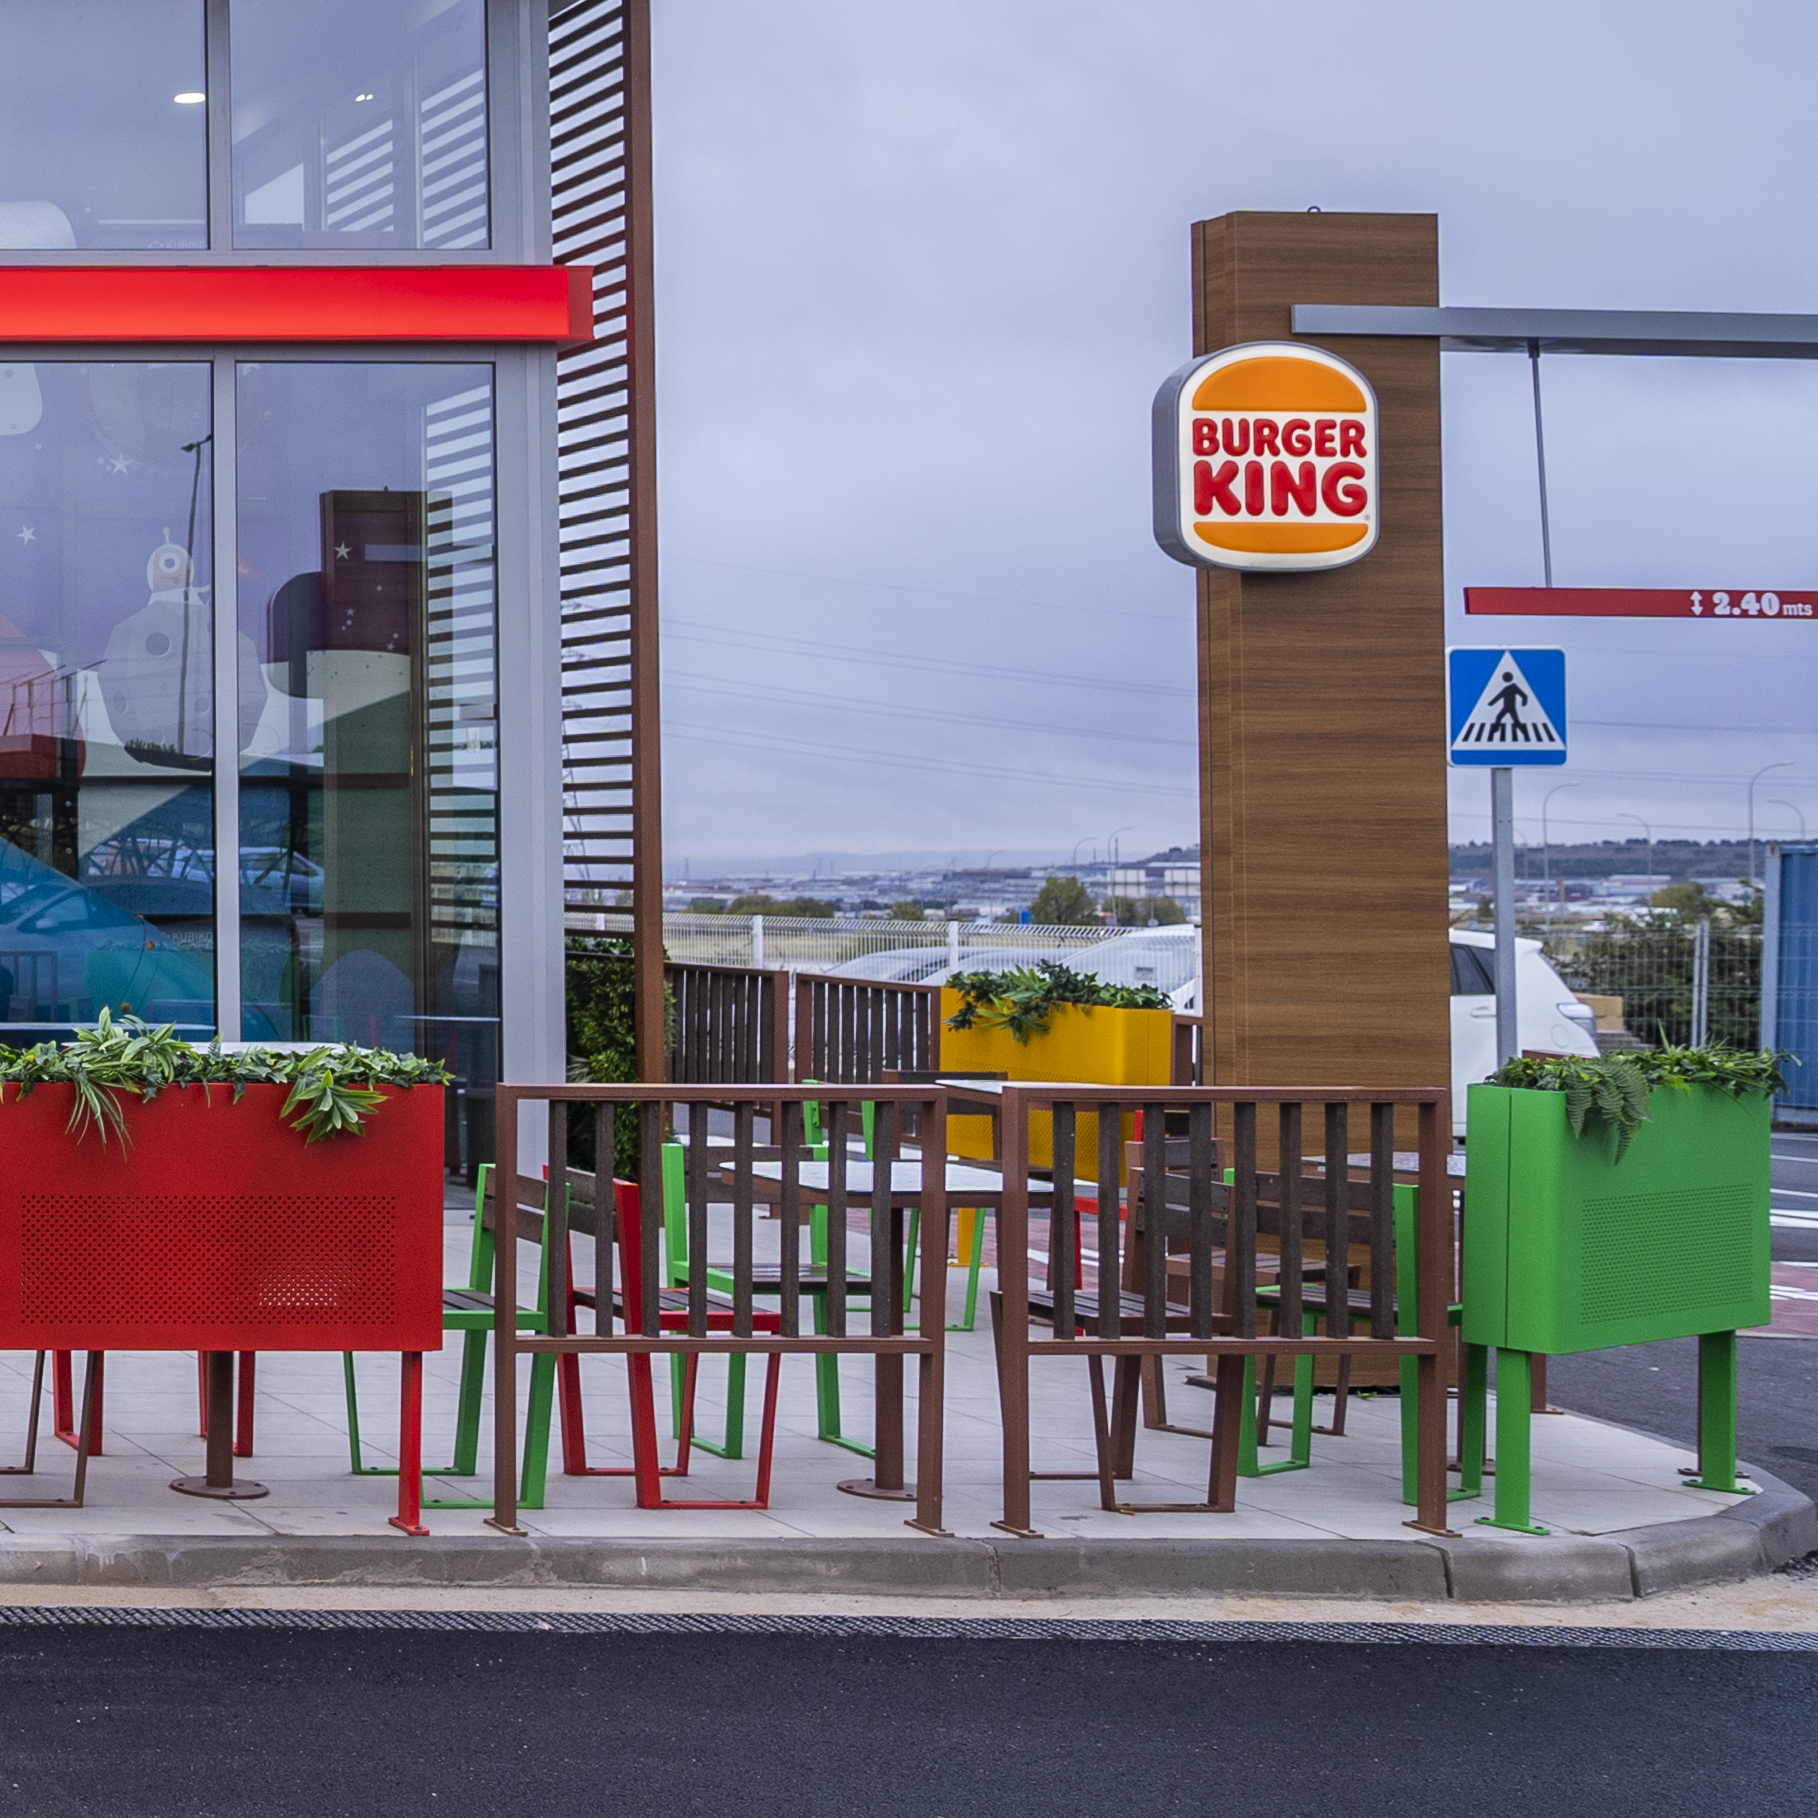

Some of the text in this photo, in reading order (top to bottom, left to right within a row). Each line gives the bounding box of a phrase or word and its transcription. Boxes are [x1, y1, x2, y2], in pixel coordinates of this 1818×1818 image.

[1192, 418, 1367, 458] BURGER
[1193, 460, 1368, 517] KING
[1712, 591, 1813, 615] 2.40 mts
